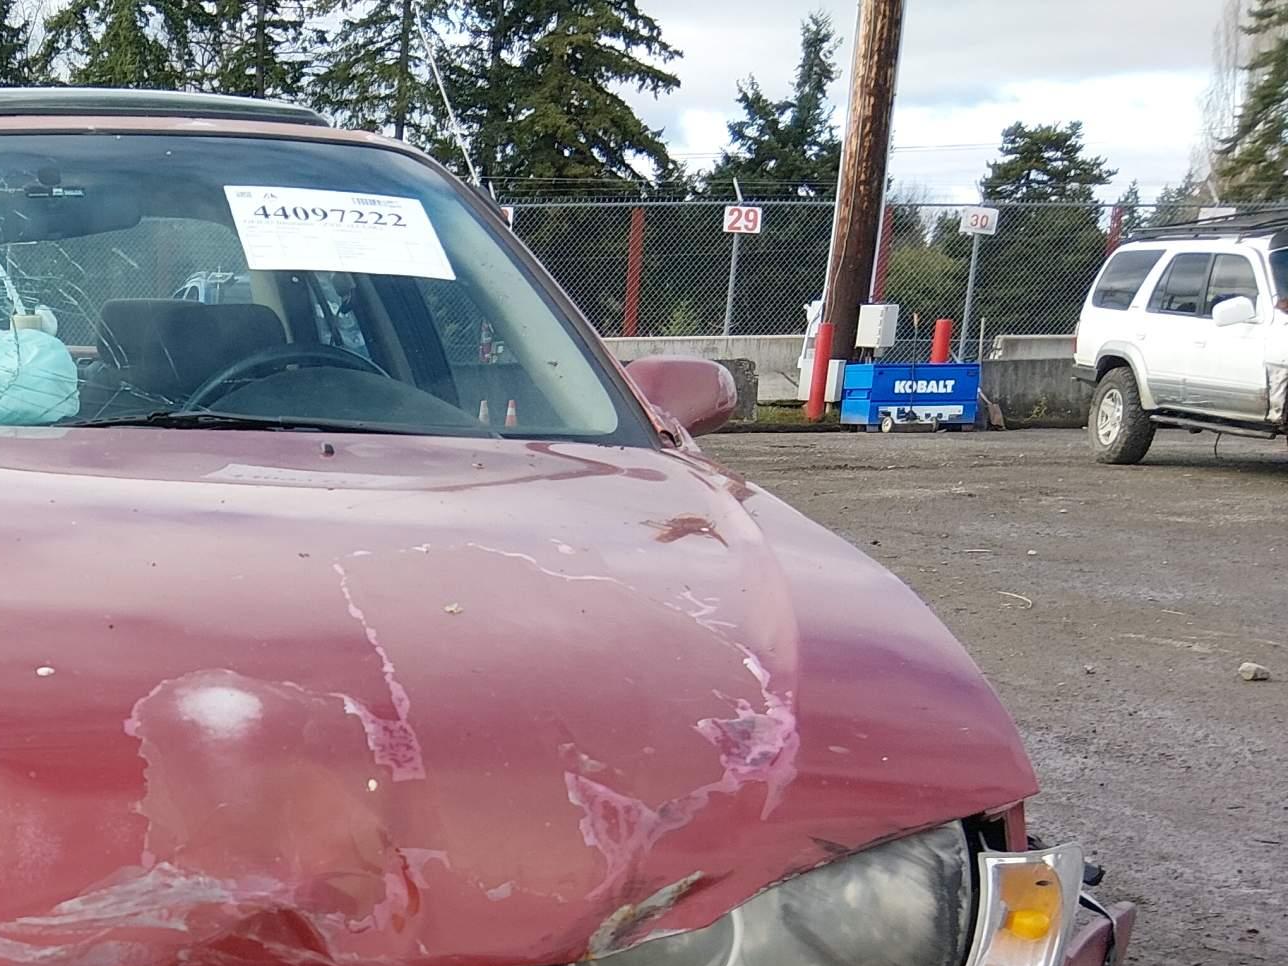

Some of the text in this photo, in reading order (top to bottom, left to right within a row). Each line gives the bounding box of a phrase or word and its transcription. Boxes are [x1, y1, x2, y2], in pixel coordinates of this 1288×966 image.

[253, 204, 407, 227] 44097222
[727, 207, 759, 231] 29
[970, 213, 990, 229] 30
[893, 379, 956, 394] KOBALT
